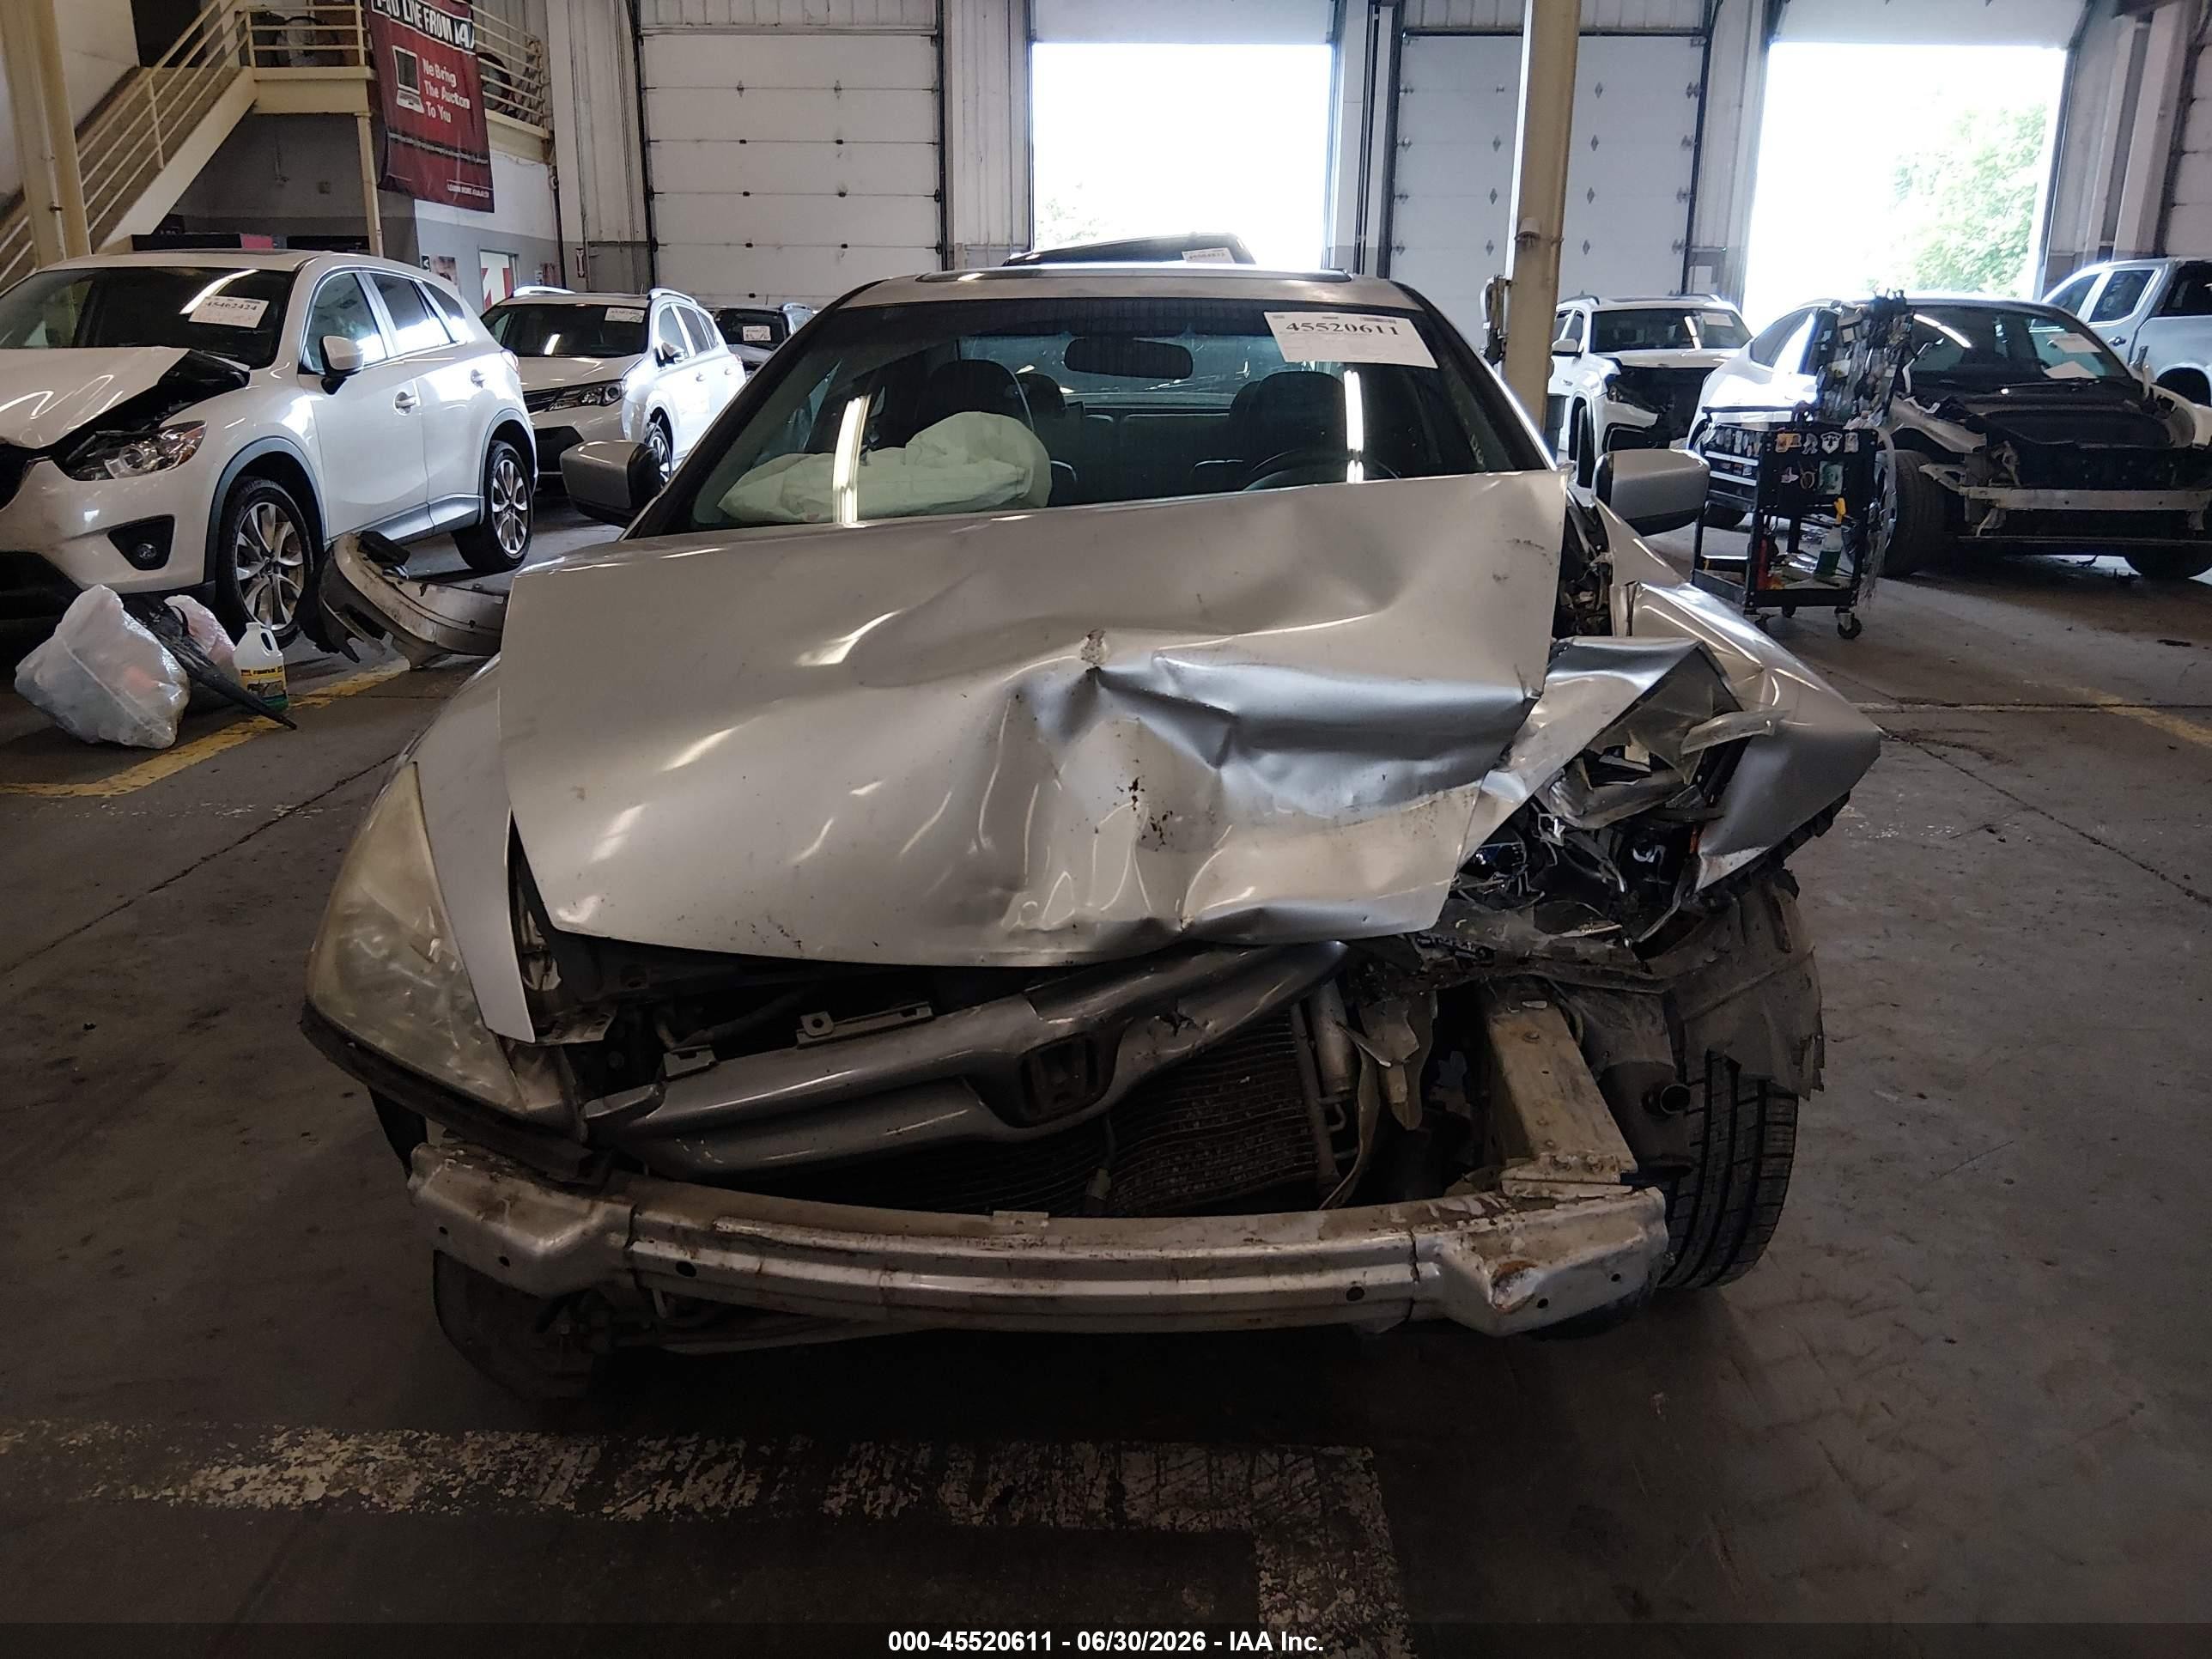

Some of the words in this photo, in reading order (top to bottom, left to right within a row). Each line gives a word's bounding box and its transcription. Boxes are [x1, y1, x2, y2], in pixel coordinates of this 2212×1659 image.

[423, 7, 453, 42] FROM
[423, 79, 440, 99] The
[425, 100, 436, 118] To
[1285, 322, 1400, 335] 45520611
